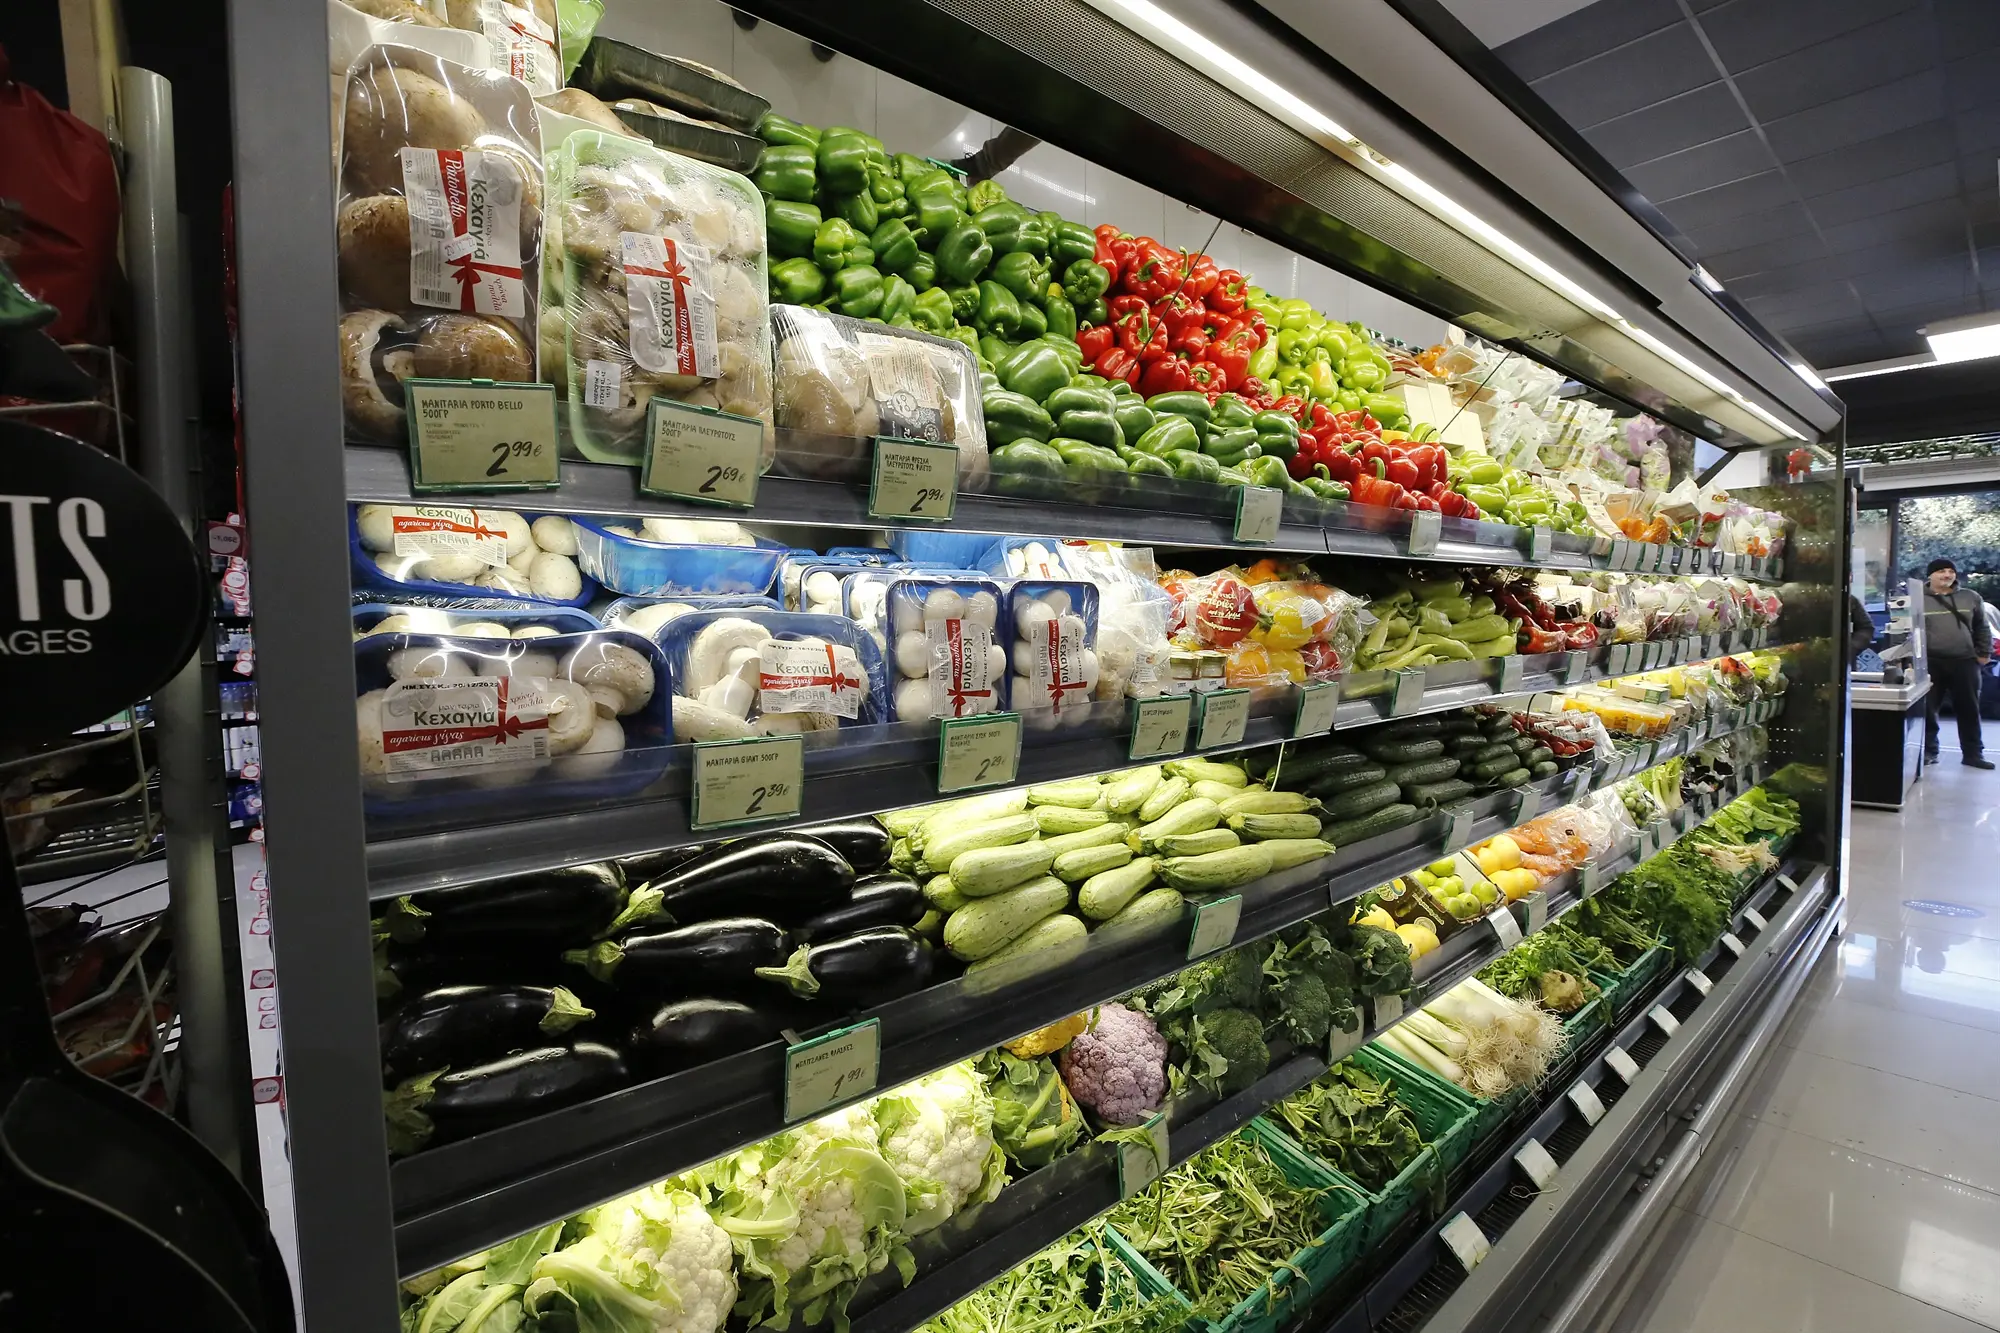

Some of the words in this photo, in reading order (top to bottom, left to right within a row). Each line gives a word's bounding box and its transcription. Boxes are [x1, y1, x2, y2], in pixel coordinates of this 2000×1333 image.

[444, 155, 467, 218] Portobello
[469, 178, 490, 260] Κεχαγιά
[657, 279, 675, 349] Κεχαγιά
[470, 399, 496, 410] PORTO
[497, 400, 524, 411] BELLO
[415, 506, 472, 525] Κεχαγιά
[0, 628, 93, 655] GES
[775, 663, 830, 676] Κεχαγιά
[962, 638, 974, 690] Κεχαγιά
[1060, 635, 1071, 684] Κεχαγιά
[413, 707, 496, 727] Κεχαγιά
[741, 755, 759, 764] GIANT
